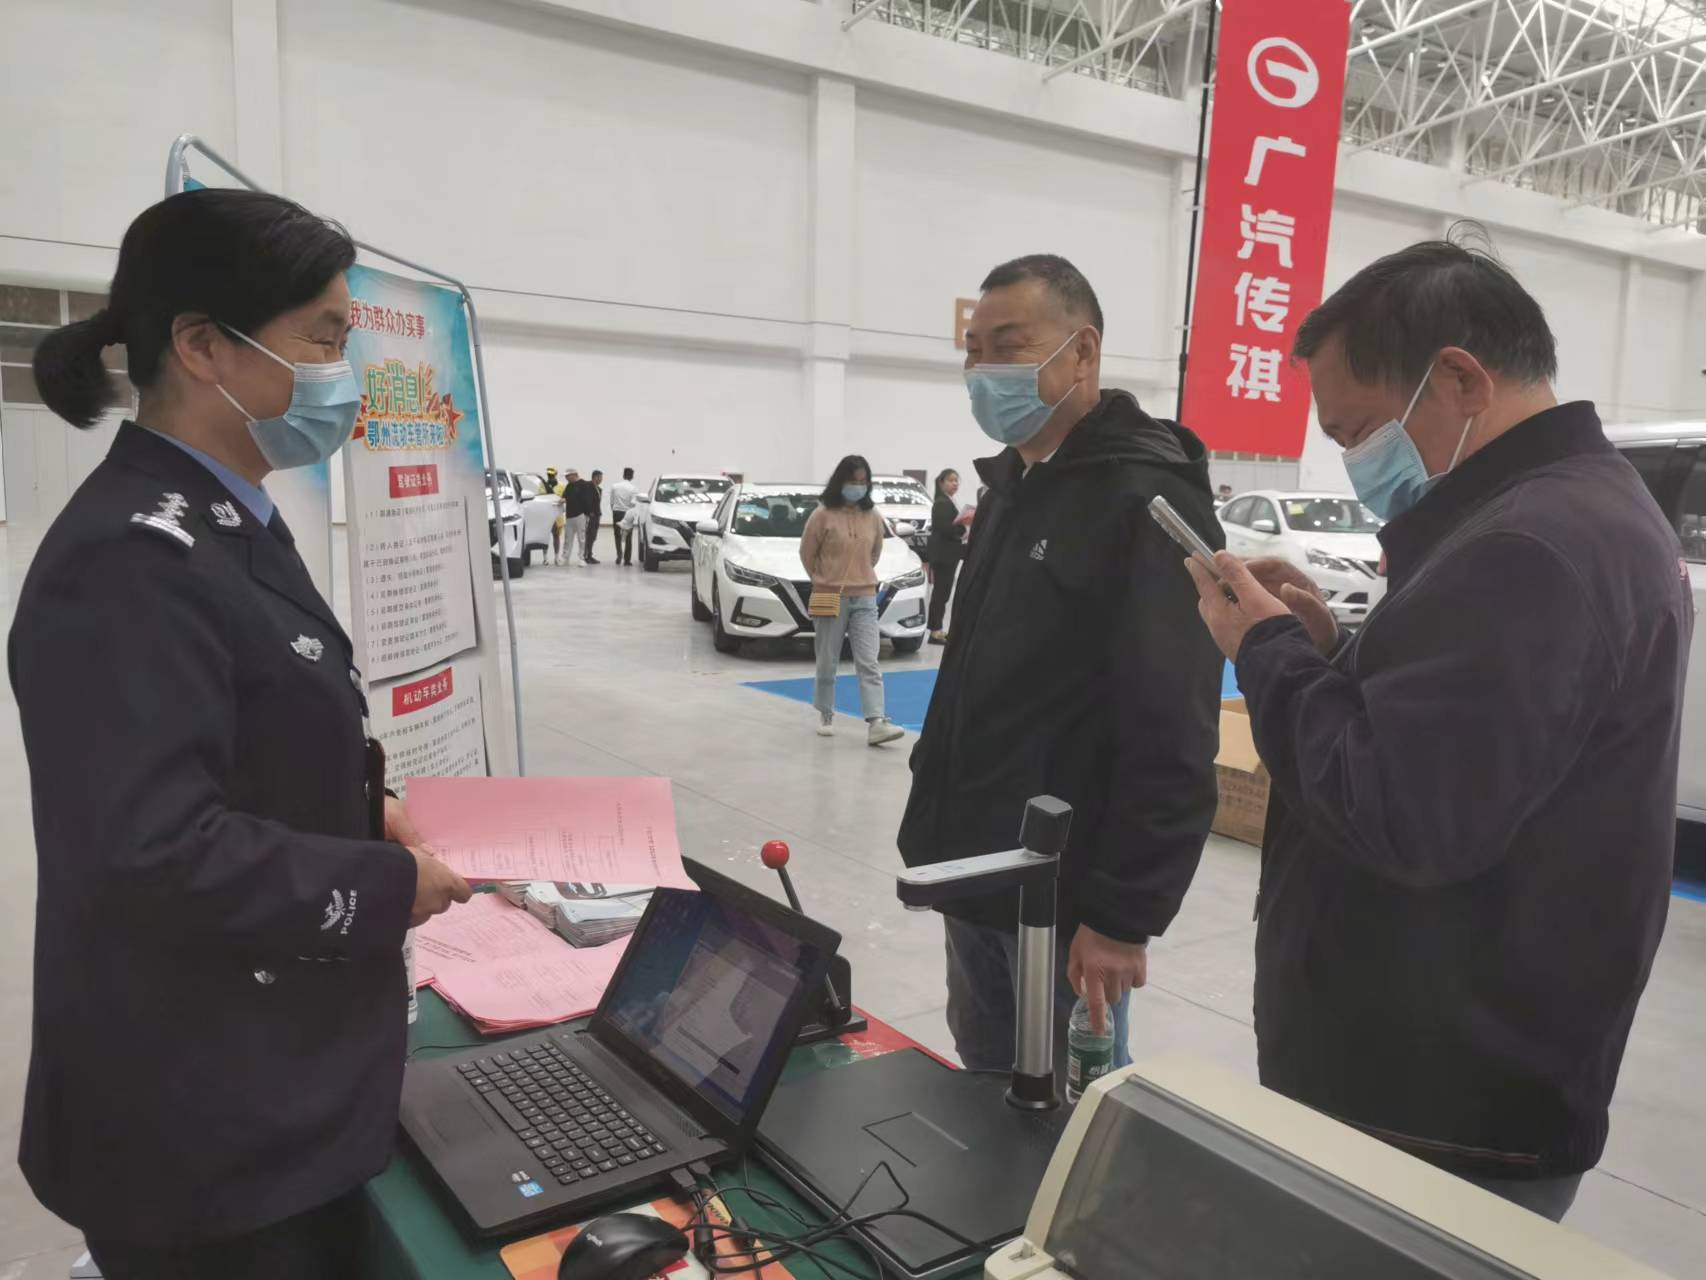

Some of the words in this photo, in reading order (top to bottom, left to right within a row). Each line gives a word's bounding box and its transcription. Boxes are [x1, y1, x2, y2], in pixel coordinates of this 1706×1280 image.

[1226, 134, 1307, 402] 广汽传祺
[340, 889, 357, 935] POLICE
